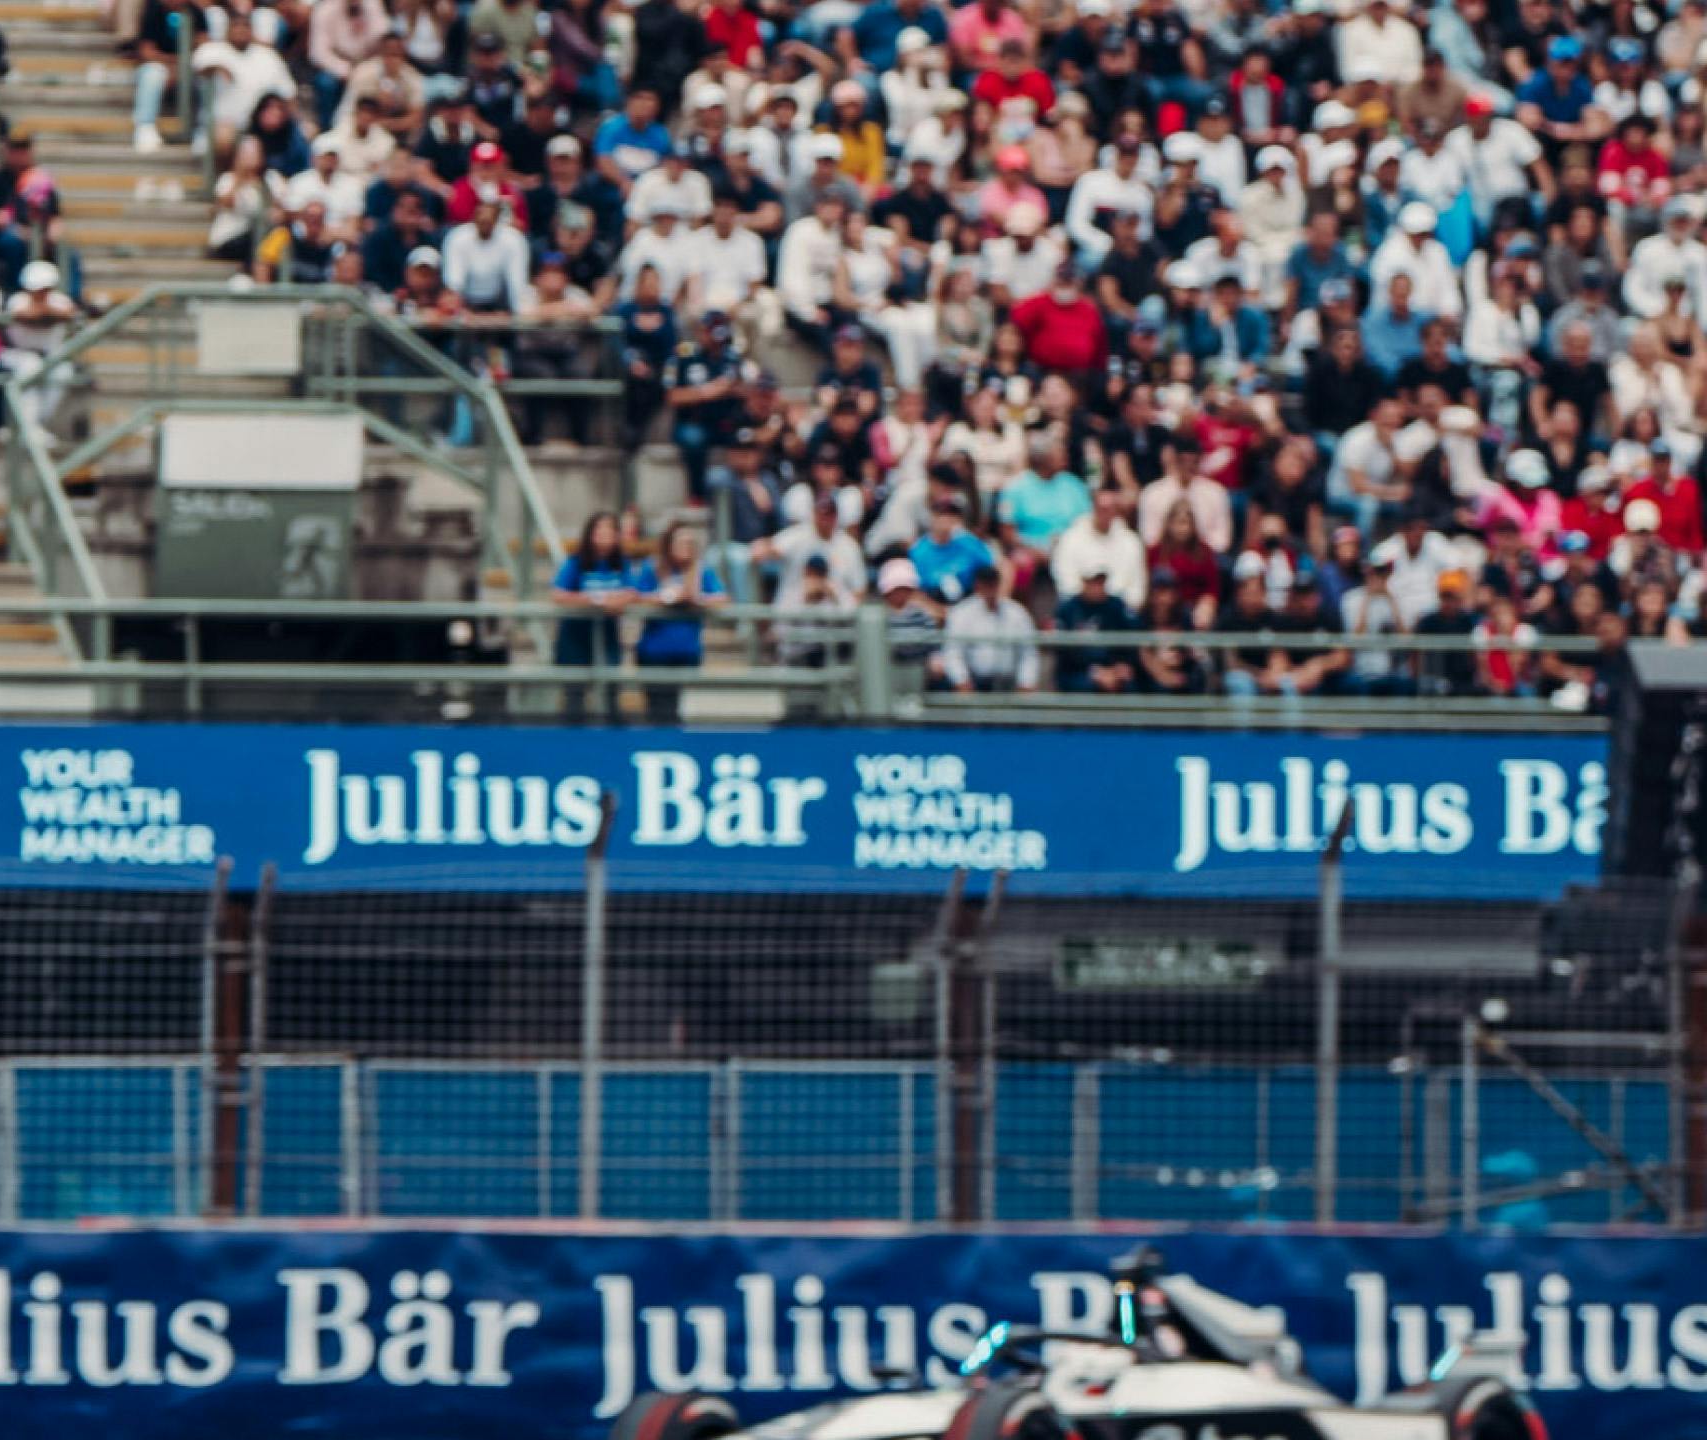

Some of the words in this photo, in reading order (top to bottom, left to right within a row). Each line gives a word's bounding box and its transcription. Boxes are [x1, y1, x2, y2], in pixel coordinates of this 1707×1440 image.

[21, 748, 133, 787] YOUR
[854, 755, 966, 793] YOUR
[21, 787, 180, 826] WEALTH
[303, 748, 603, 865] Julius
[631, 750, 826, 847] Bär
[854, 793, 1013, 832] WEALTH
[1173, 756, 1473, 872] Julius
[1499, 759, 1609, 854] Bä
[21, 825, 215, 865] MANAGER
[854, 831, 1046, 871] MANAGER
[276, 1269, 539, 1388] Bär
[593, 1273, 986, 1418] Julius
